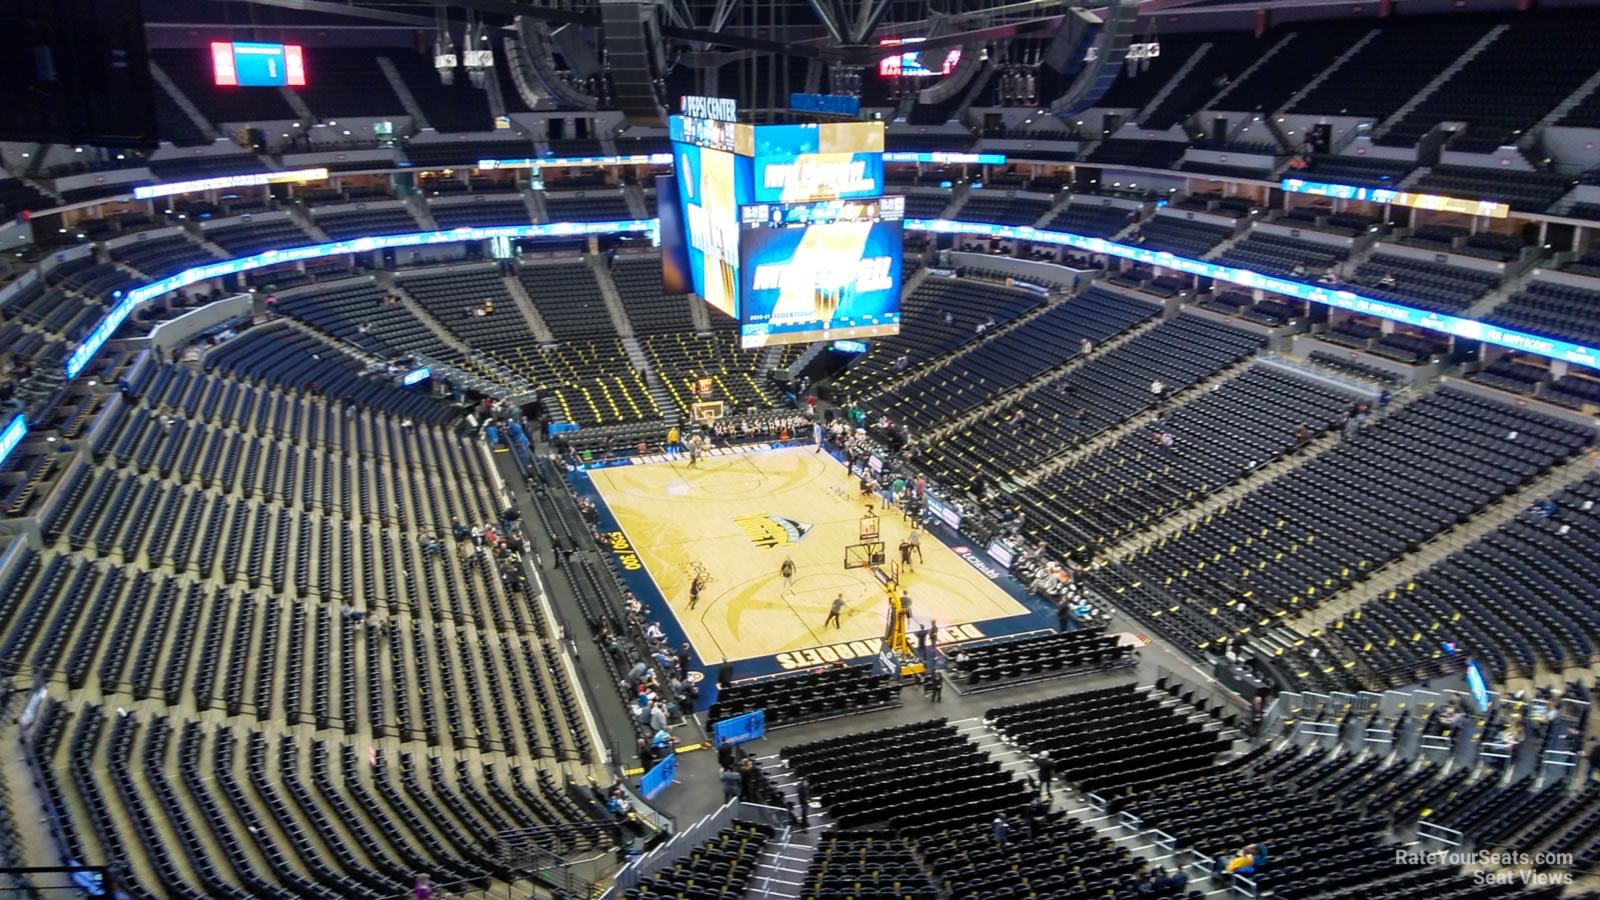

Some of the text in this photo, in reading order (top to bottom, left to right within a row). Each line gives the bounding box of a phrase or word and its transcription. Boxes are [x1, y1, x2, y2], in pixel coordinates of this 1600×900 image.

[687, 96, 737, 122] PEPSI CENTER
[776, 637, 882, 670] NUGGETS
